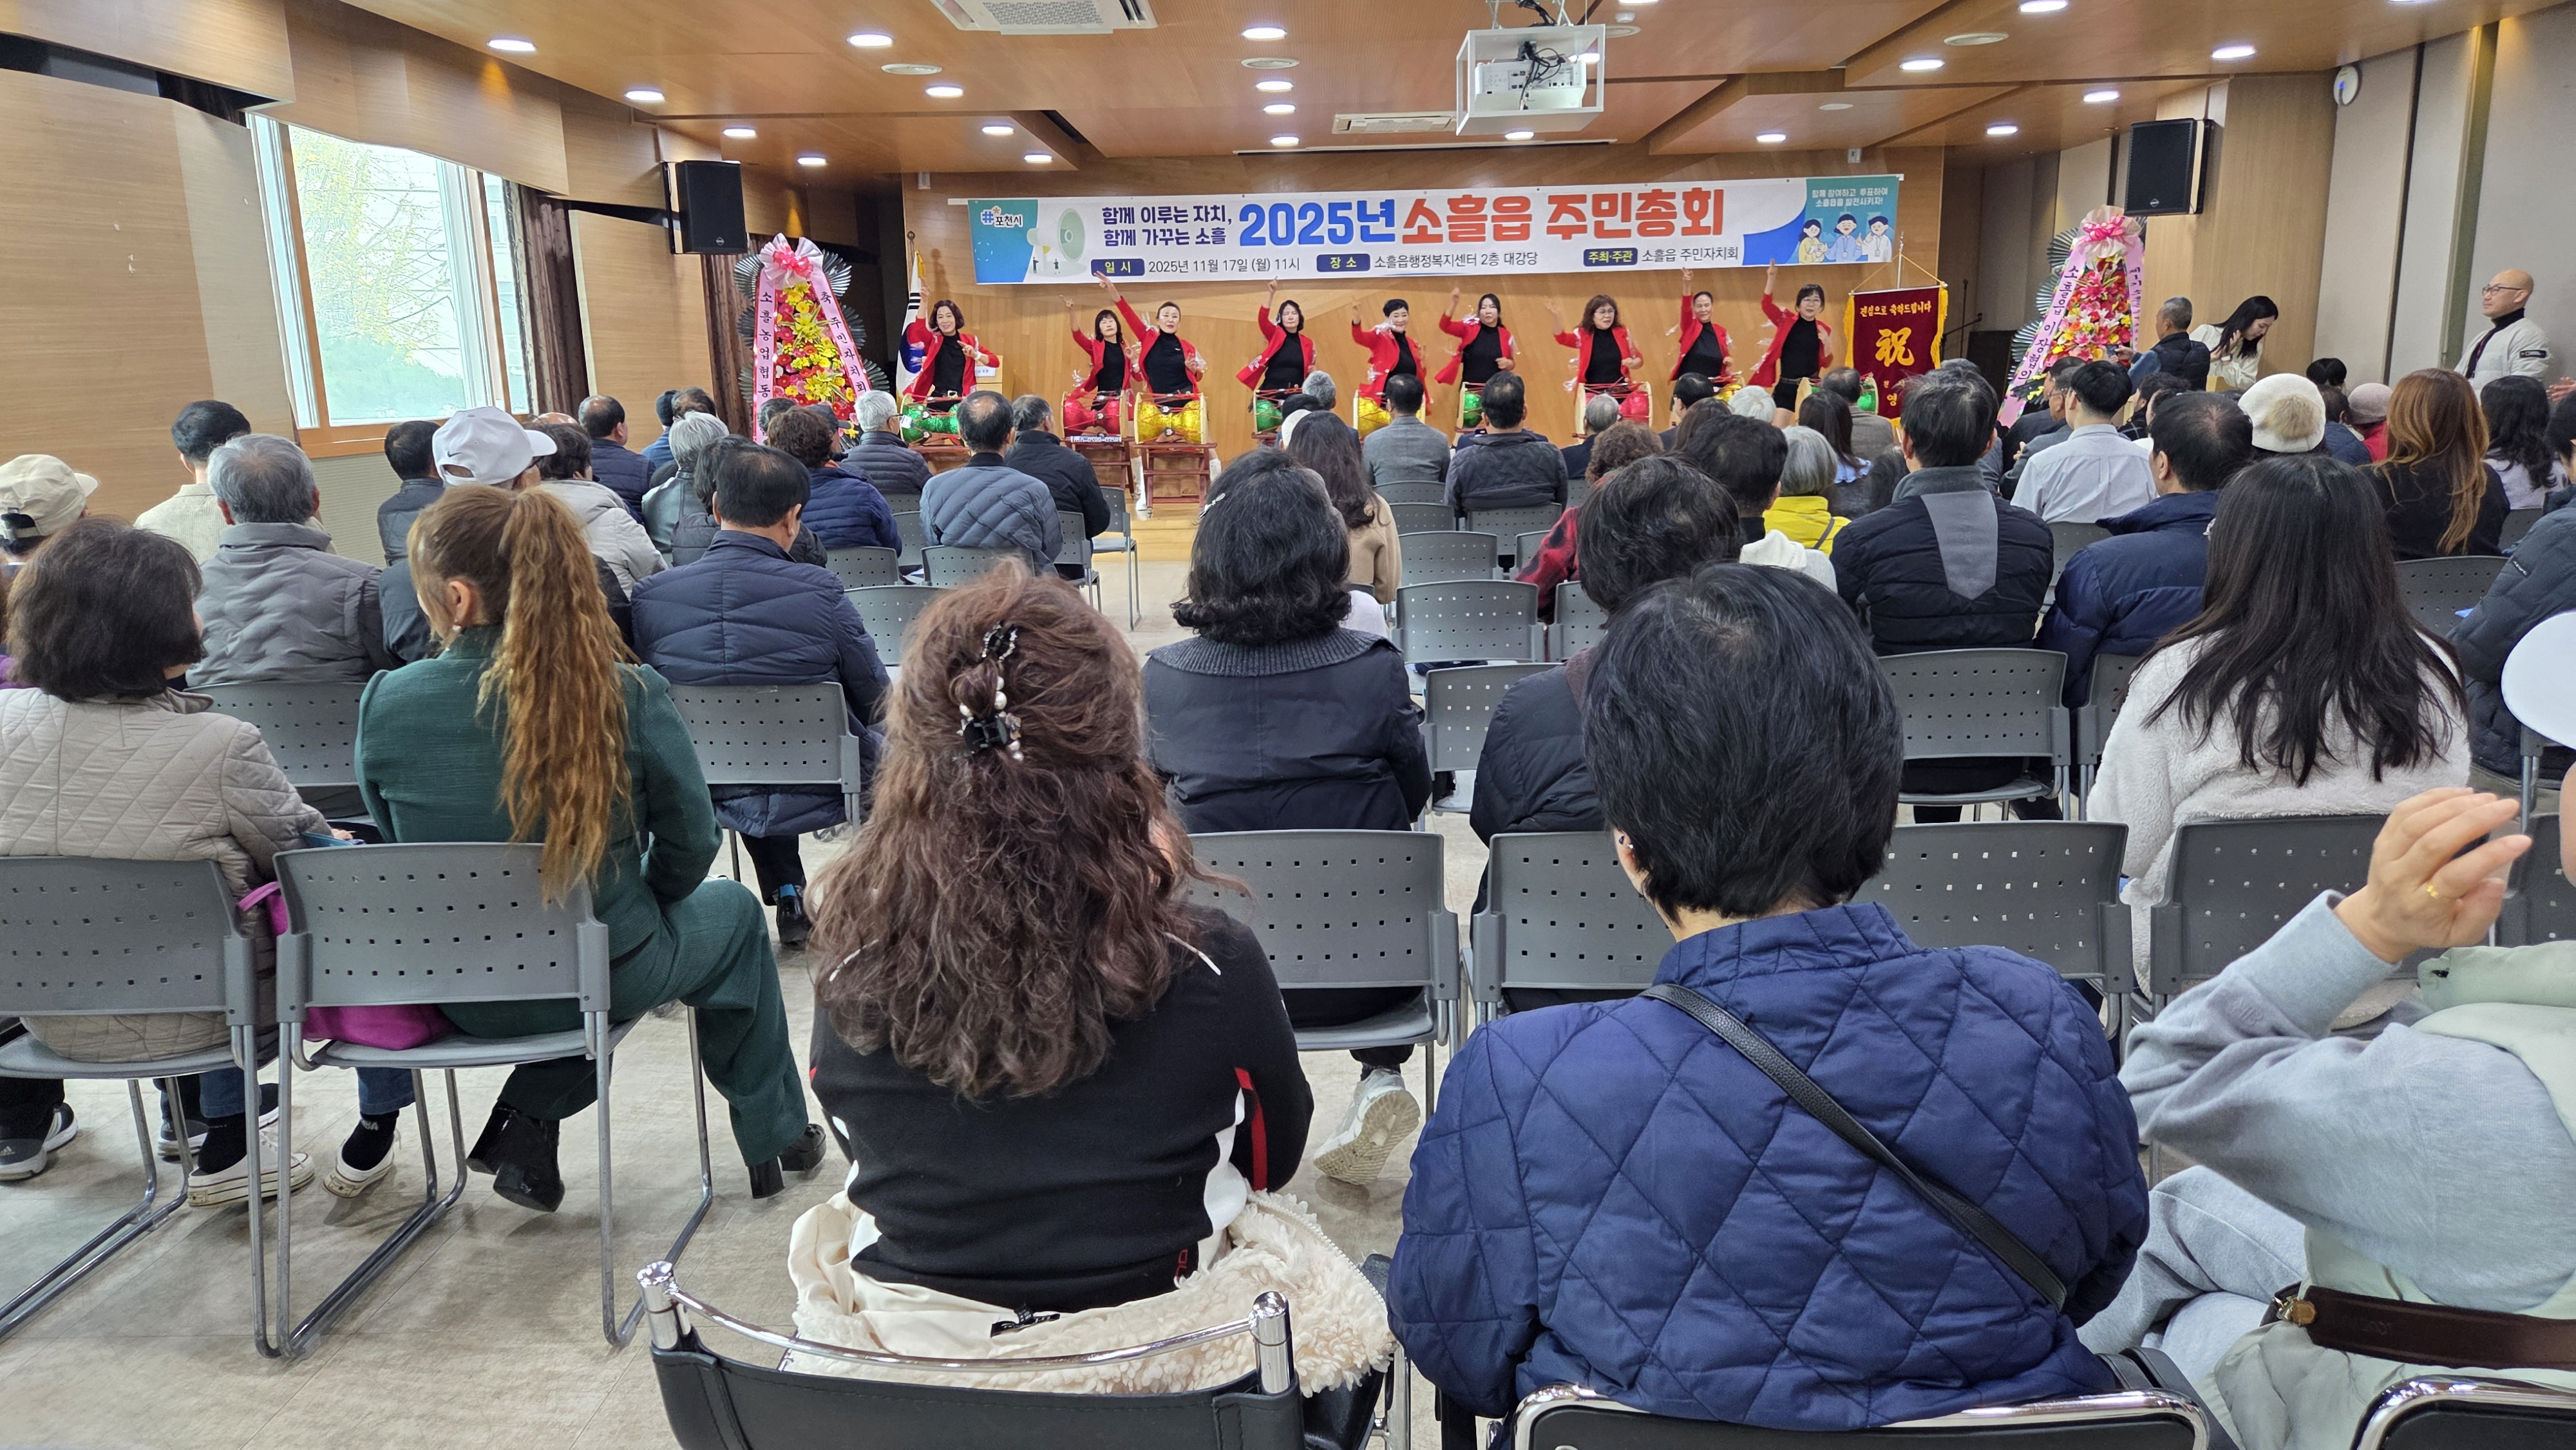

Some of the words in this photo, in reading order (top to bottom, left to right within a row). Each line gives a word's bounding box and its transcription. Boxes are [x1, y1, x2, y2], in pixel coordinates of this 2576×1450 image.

[1102, 207, 1135, 225] 함께
[1141, 206, 1189, 224] 이루는
[1193, 205, 1232, 225] 자치,
[1546, 187, 1724, 240] 주민총회
[1104, 229, 1136, 247] 함께
[1142, 228, 1190, 246] 가꾸는
[1195, 227, 1226, 245] 소흘
[1148, 260, 1189, 273] 2025년
[1193, 259, 1218, 272] 11월
[1222, 258, 1248, 272] 17일
[1251, 258, 1271, 272] (월)
[1274, 257, 1300, 271] 11시
[1374, 253, 1477, 268] 소흘읍행정복지센터
[1481, 252, 1500, 266] 2층
[1504, 252, 1538, 265] 대강당
[1642, 249, 1676, 263] 소흘읍
[1680, 247, 1738, 262] 주민자치회
[820, 291, 831, 304] 축
[830, 317, 867, 392] 주민자치회
[1875, 327, 1915, 367] 祝
